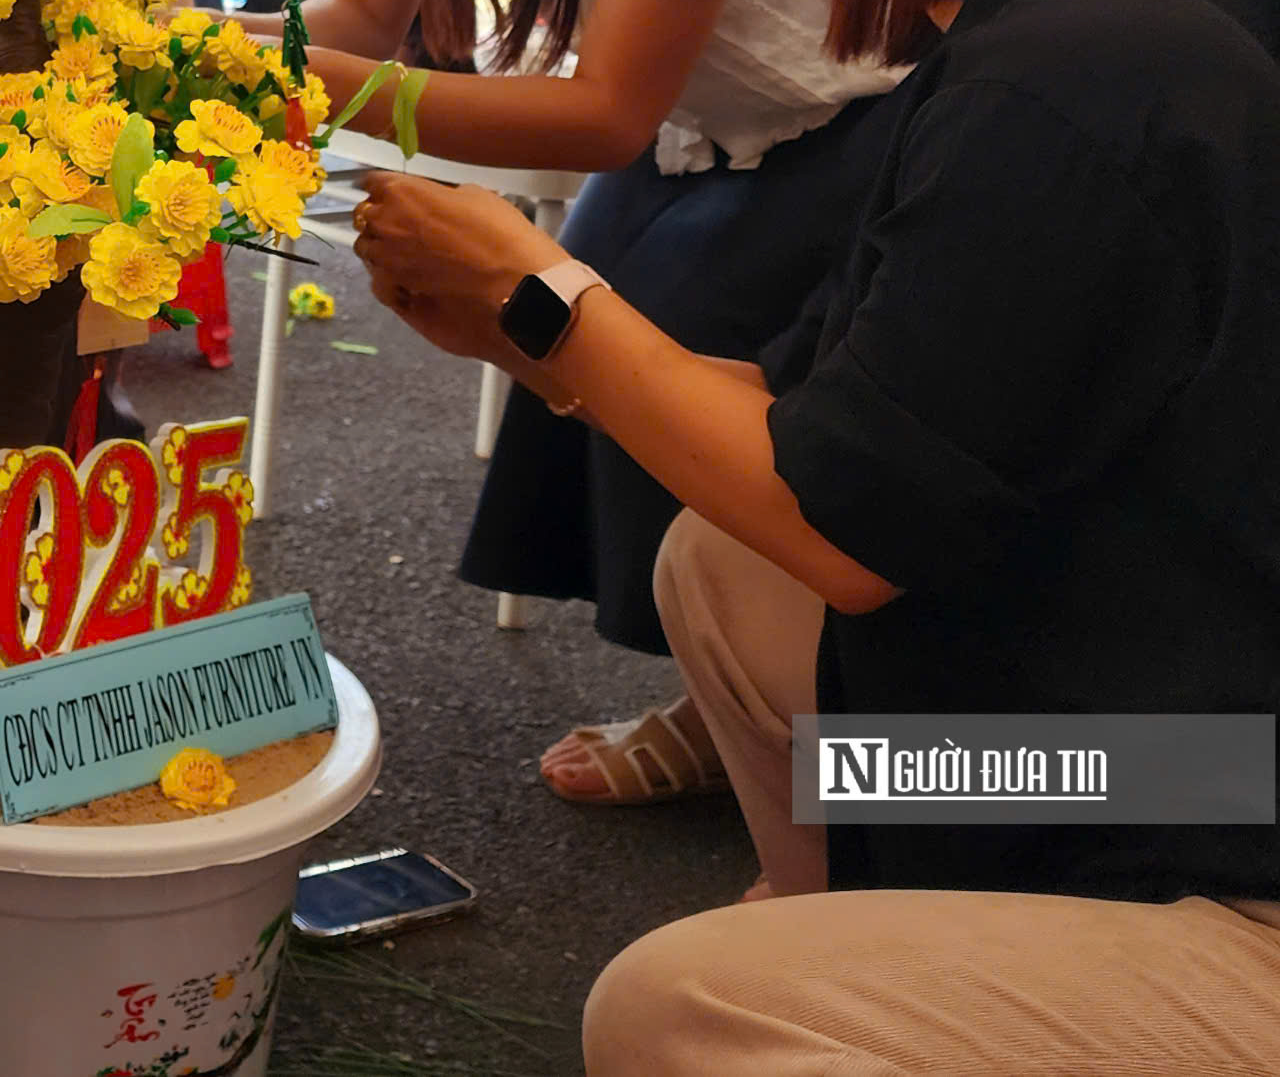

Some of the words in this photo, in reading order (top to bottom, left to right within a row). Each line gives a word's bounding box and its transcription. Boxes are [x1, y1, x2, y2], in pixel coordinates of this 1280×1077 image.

[4, 706, 57, 786] CĐCS
[57, 699, 85, 771] CT
[82, 684, 142, 762] TNHH
[138, 669, 200, 748] JASON
[192, 645, 296, 730] FURNITURE
[290, 636, 324, 700] VN
